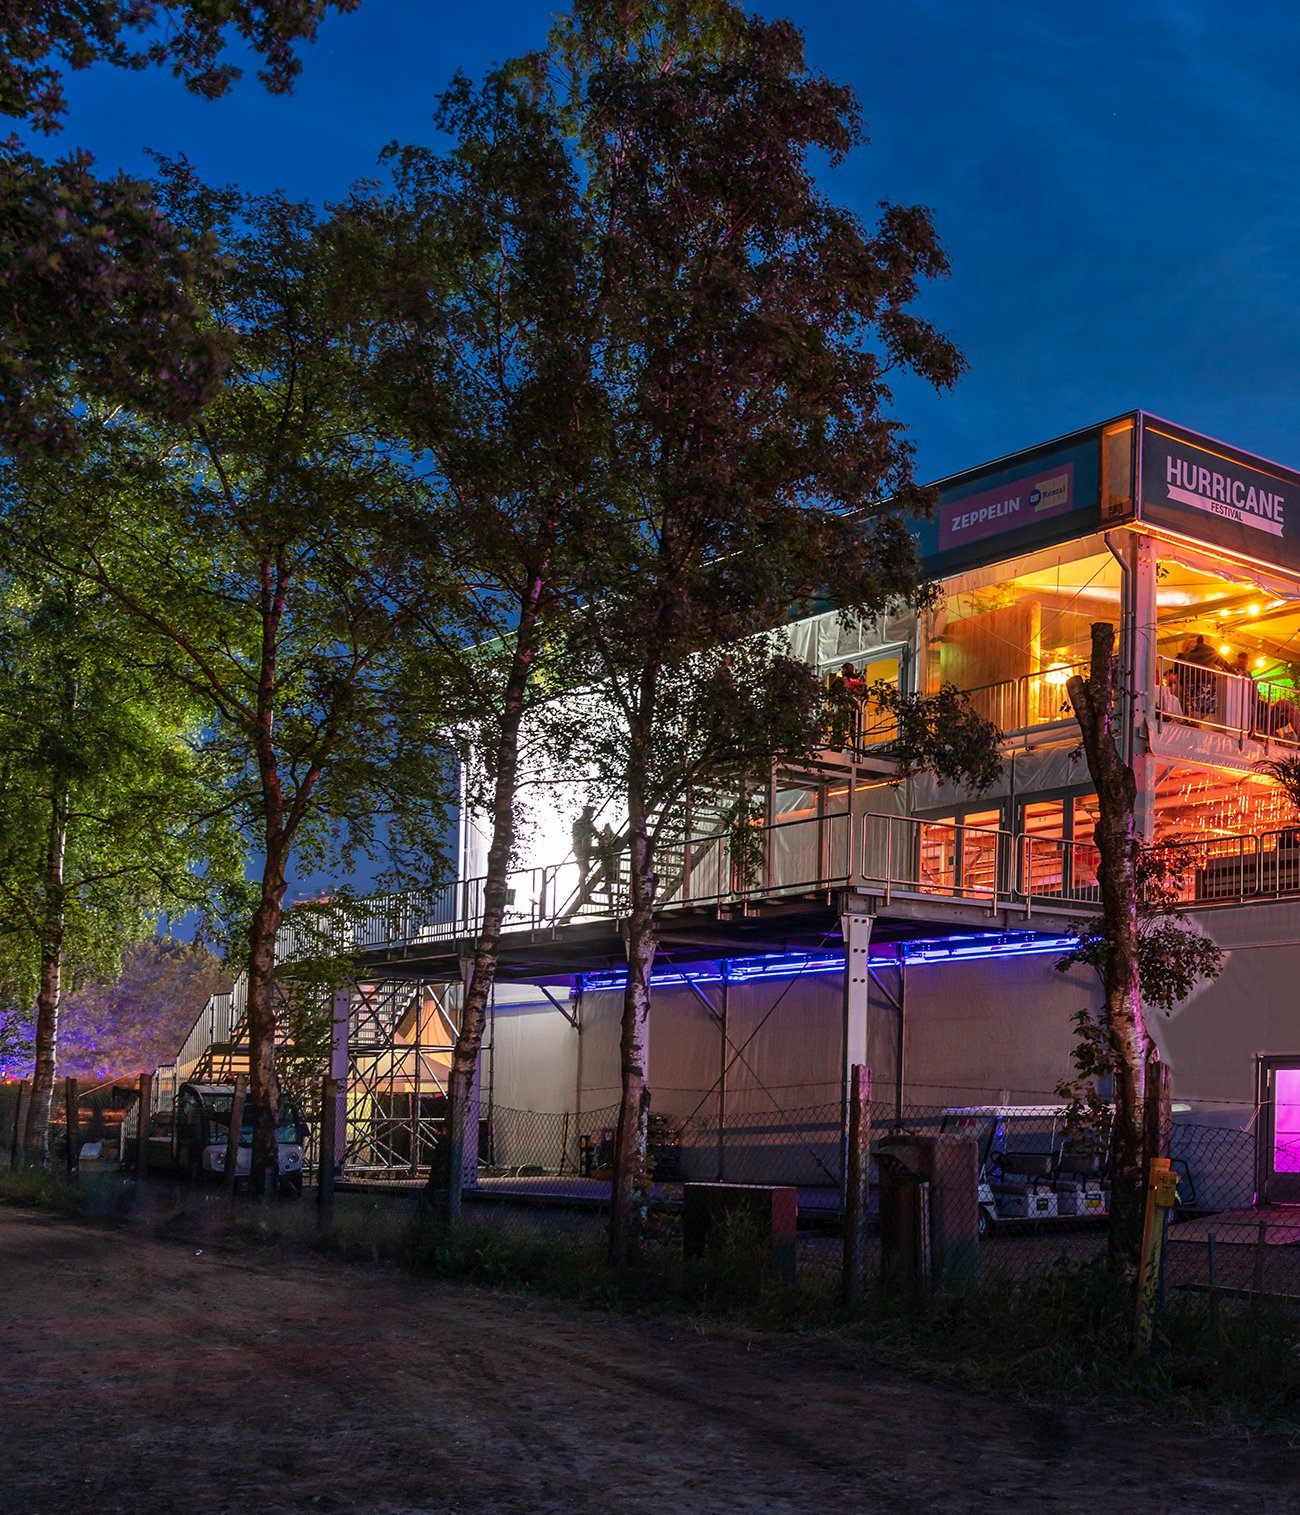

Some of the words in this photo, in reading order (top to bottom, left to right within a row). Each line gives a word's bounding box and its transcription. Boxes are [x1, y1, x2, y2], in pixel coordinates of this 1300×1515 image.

[1042, 485, 1066, 499] Rental
[1166, 455, 1285, 522] HURRICANE
[951, 496, 1021, 532] ZEPPELIN
[1211, 502, 1243, 522] FESTIVAL
